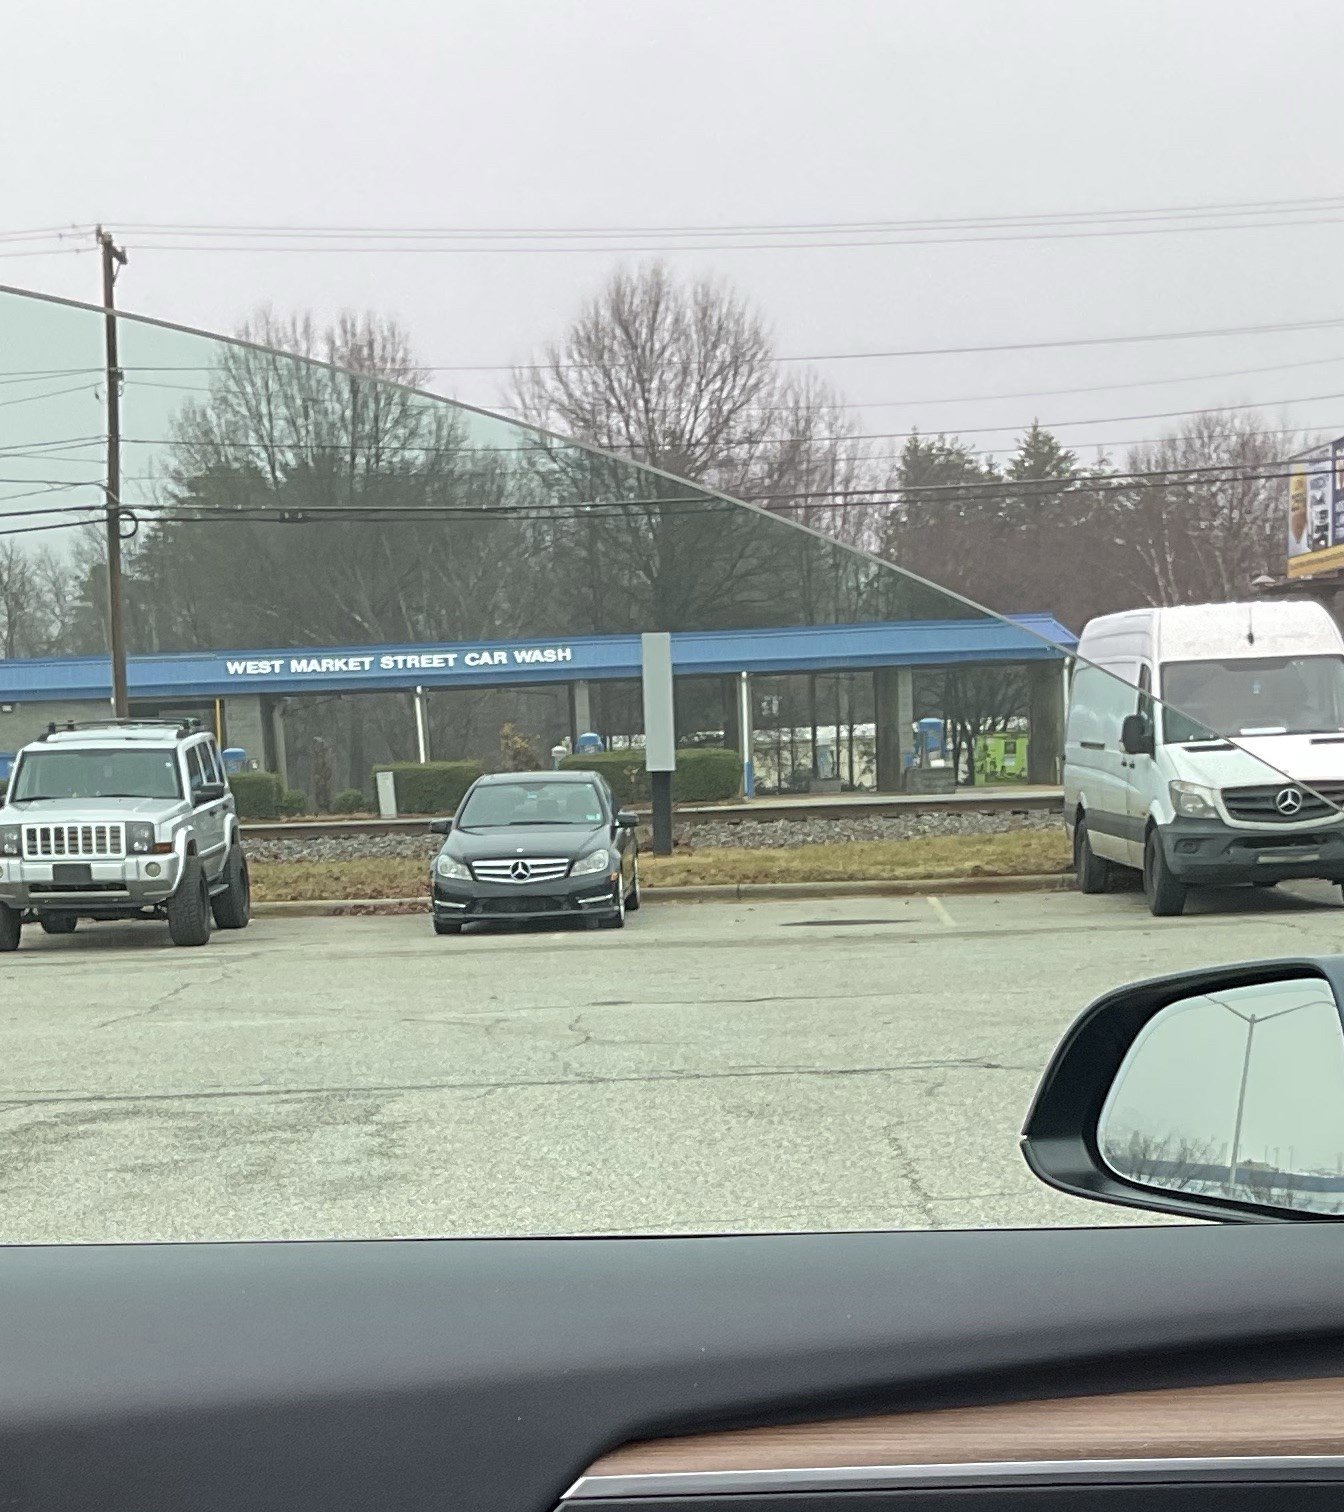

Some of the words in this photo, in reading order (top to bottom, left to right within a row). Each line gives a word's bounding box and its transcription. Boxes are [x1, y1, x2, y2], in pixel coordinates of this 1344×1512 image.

[226, 660, 284, 675] WEST
[290, 657, 375, 673] MARKET
[380, 654, 458, 670] STREET
[464, 651, 508, 667] CAR
[514, 648, 572, 664] WASH
